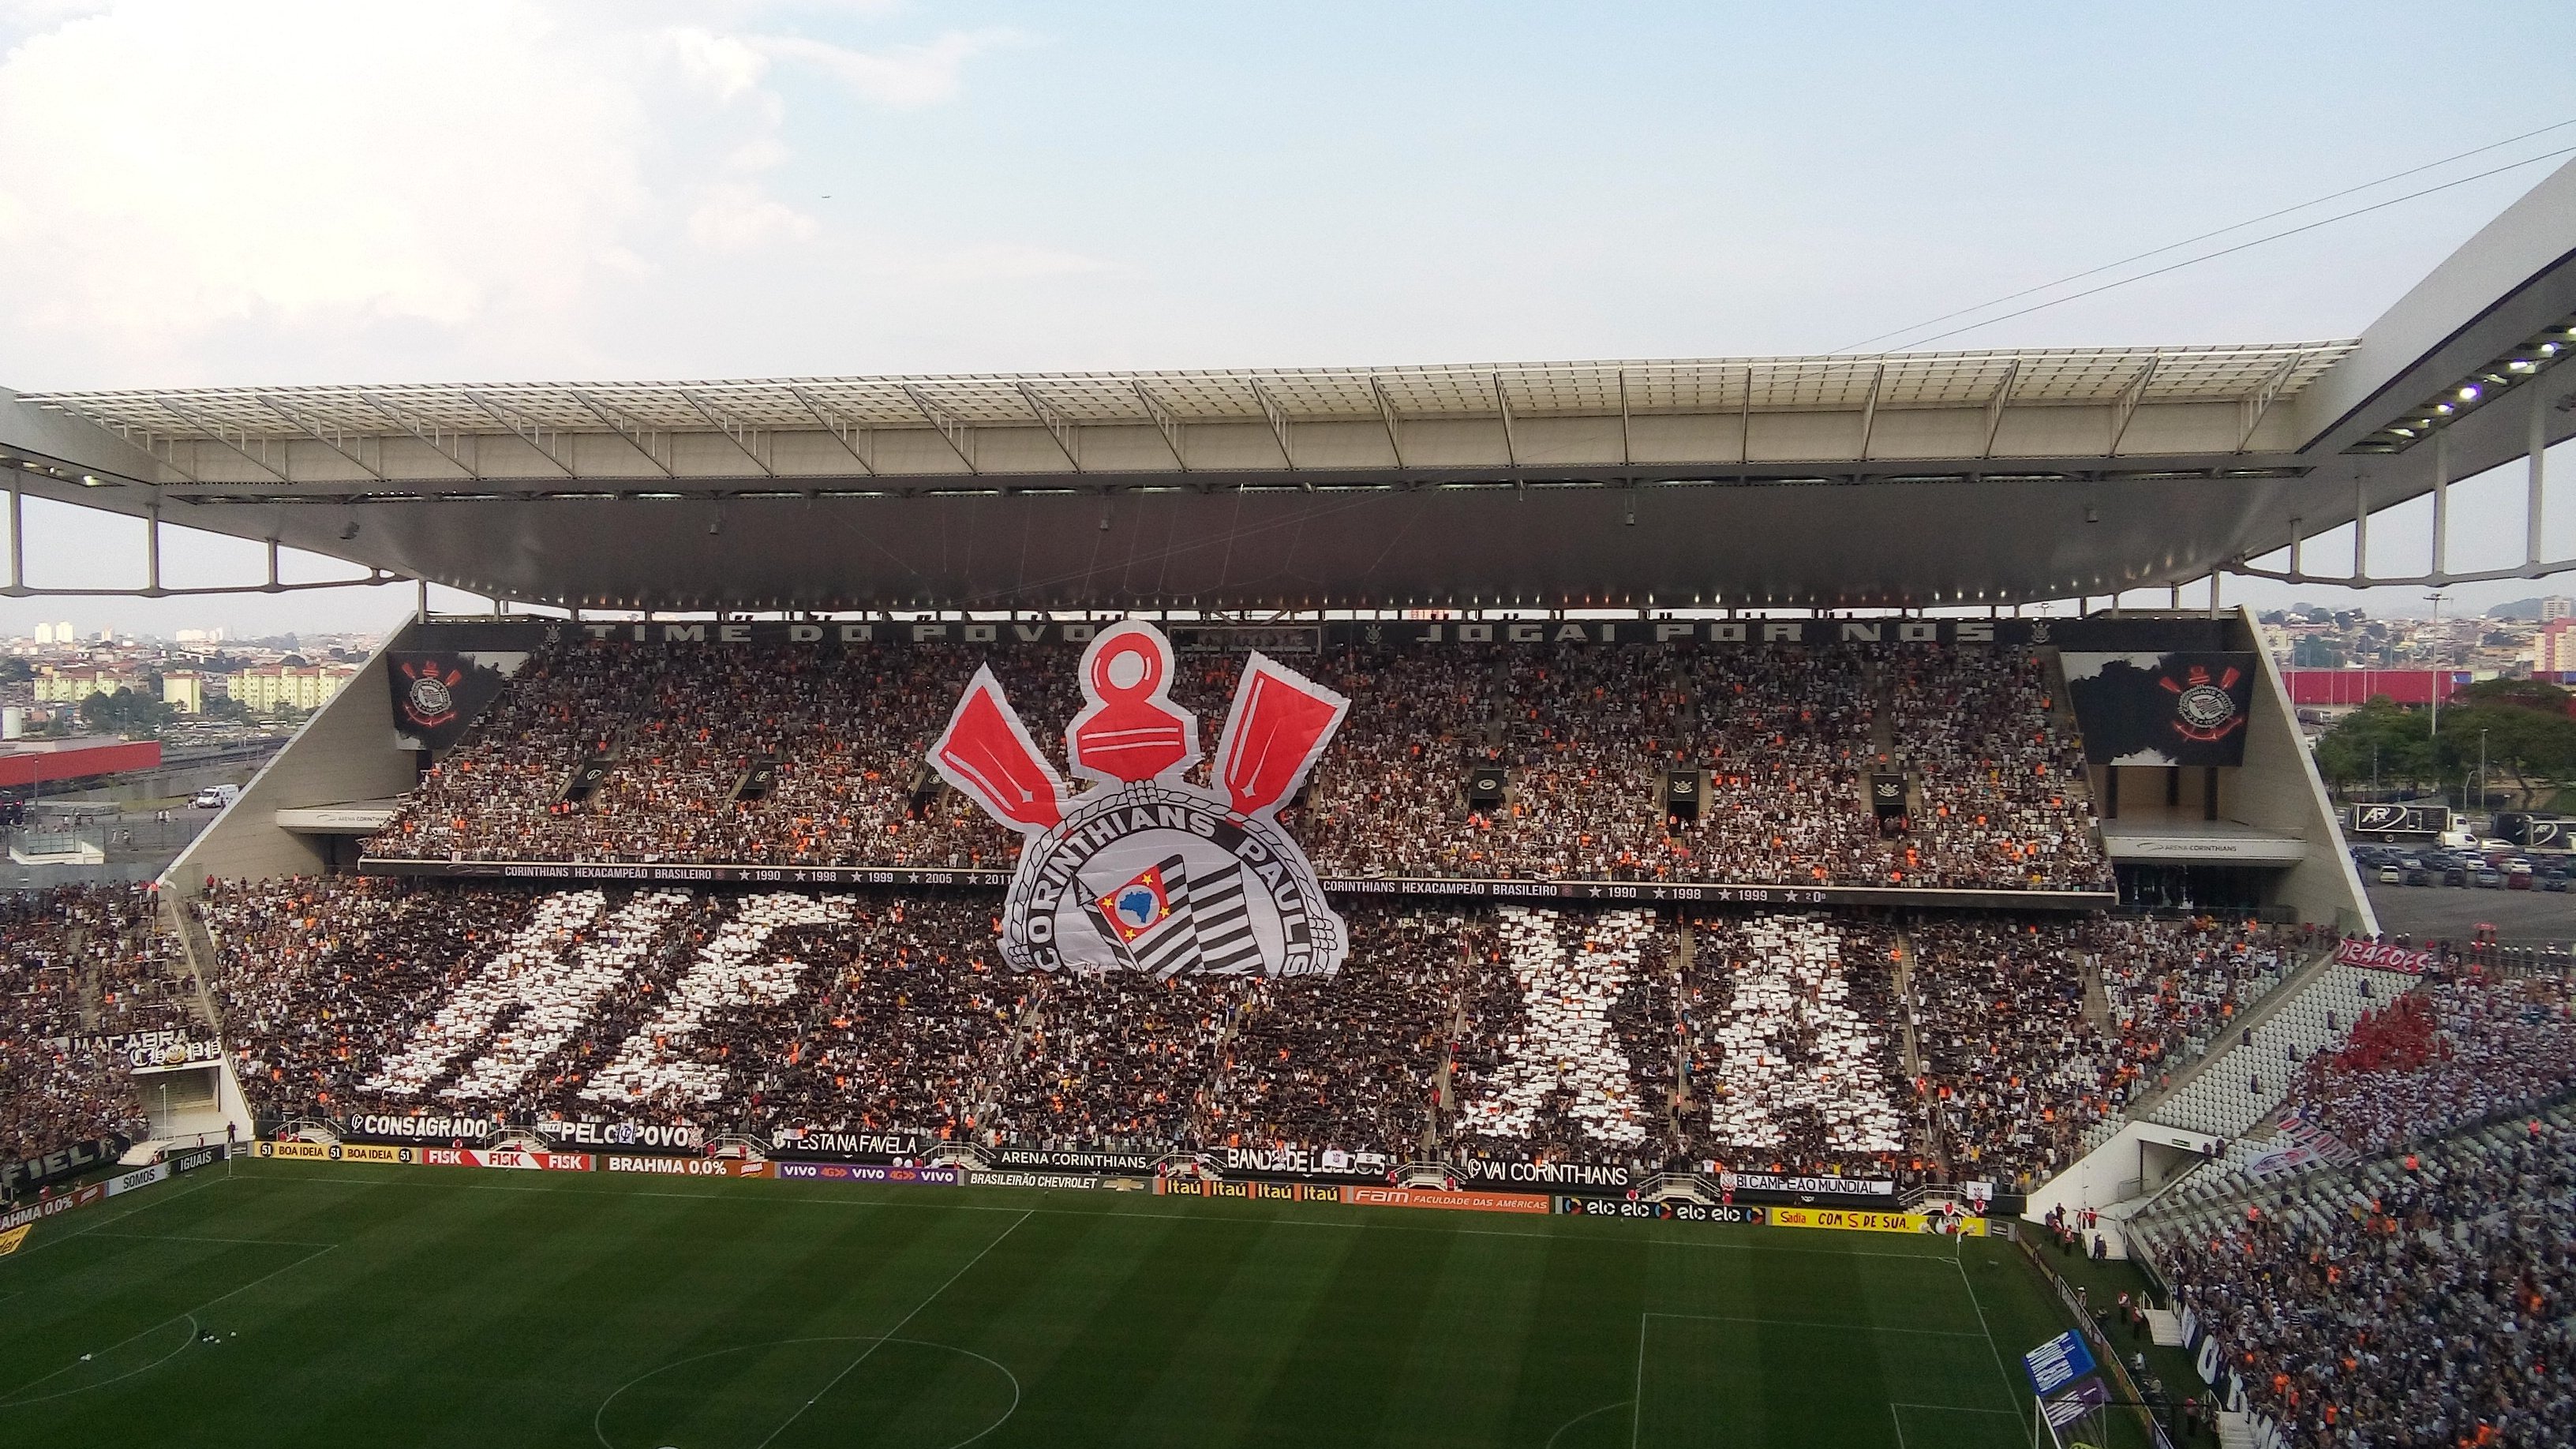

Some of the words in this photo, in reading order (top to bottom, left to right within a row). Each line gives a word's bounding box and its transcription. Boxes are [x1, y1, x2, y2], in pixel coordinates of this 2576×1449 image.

[585, 624, 751, 642] TIME
[790, 624, 873, 642] DO
[913, 624, 1095, 642] POVO
[1416, 624, 1615, 642] JOGAI
[1657, 623, 1802, 642] POR
[1842, 623, 1994, 642] NOS
[504, 867, 569, 878] CORINTHIANS
[575, 867, 648, 878] HEXACAMPEÃO
[654, 869, 712, 880] BRASILEIRO
[755, 871, 781, 881] 1990
[811, 871, 837, 882] 1998
[868, 872, 893, 882] 1999
[925, 873, 953, 884] 2005
[985, 874, 1012, 885] 2011
[1028, 805, 1215, 972] CORINTHIANS
[1323, 881, 1395, 893] CORINTHIANS
[1402, 882, 1485, 895] HEXACAMPEÃO
[1492, 884, 1558, 897] BRASILEIRO
[1608, 887, 1637, 898] 1990
[1672, 888, 1702, 900] 1998
[1738, 889, 1768, 901] 1999
[365, 1114, 488, 1137] CONSAGRADO
[181, 1151, 212, 1172] IGUAIS
[260, 1145, 272, 1156] 51
[279, 1146, 298, 1156] BOA
[300, 1147, 323, 1158] IDEIA
[329, 1147, 342, 1158] 51
[347, 1148, 367, 1159] BOA
[369, 1149, 392, 1160] IDEIA
[399, 1150, 412, 1162] 51
[429, 1151, 462, 1164] FISK
[489, 1153, 522, 1166] FISK
[549, 1155, 582, 1170] FISK
[1001, 1151, 1049, 1165] ARENA
[1052, 1152, 1146, 1169] CORINTHIANS
[1287, 1149, 1309, 1172] DE
[0, 1145, 94, 1187] FIEL
[608, 1157, 684, 1174] BRAHMA
[689, 1159, 727, 1176] 0,0%
[1482, 1161, 1506, 1181] VAI
[1511, 1163, 1629, 1186] CORINTHIANS
[124, 1170, 155, 1189] SOMOS
[971, 1172, 1035, 1187] BRASILEIRÃO
[1038, 1174, 1098, 1190] CHEVROLET
[1818, 1179, 1880, 1194] MUNDIAL
[1167, 1180, 1201, 1195] Itaú
[1213, 1181, 1246, 1197] Itaú
[1258, 1184, 1292, 1200] Itaú
[1304, 1185, 1339, 1202] Itaú
[1413, 1195, 1470, 1206] FACULDADE
[1496, 1198, 1548, 1209] AMÉRICAS
[1587, 1200, 1616, 1215] elo
[1621, 1201, 1649, 1218] elo
[1677, 1204, 1706, 1221] elo
[1711, 1206, 1741, 1222] elo
[1780, 1211, 1807, 1223] Sadia
[1818, 1213, 1842, 1225] COM
[1863, 1216, 1877, 1227] DE
